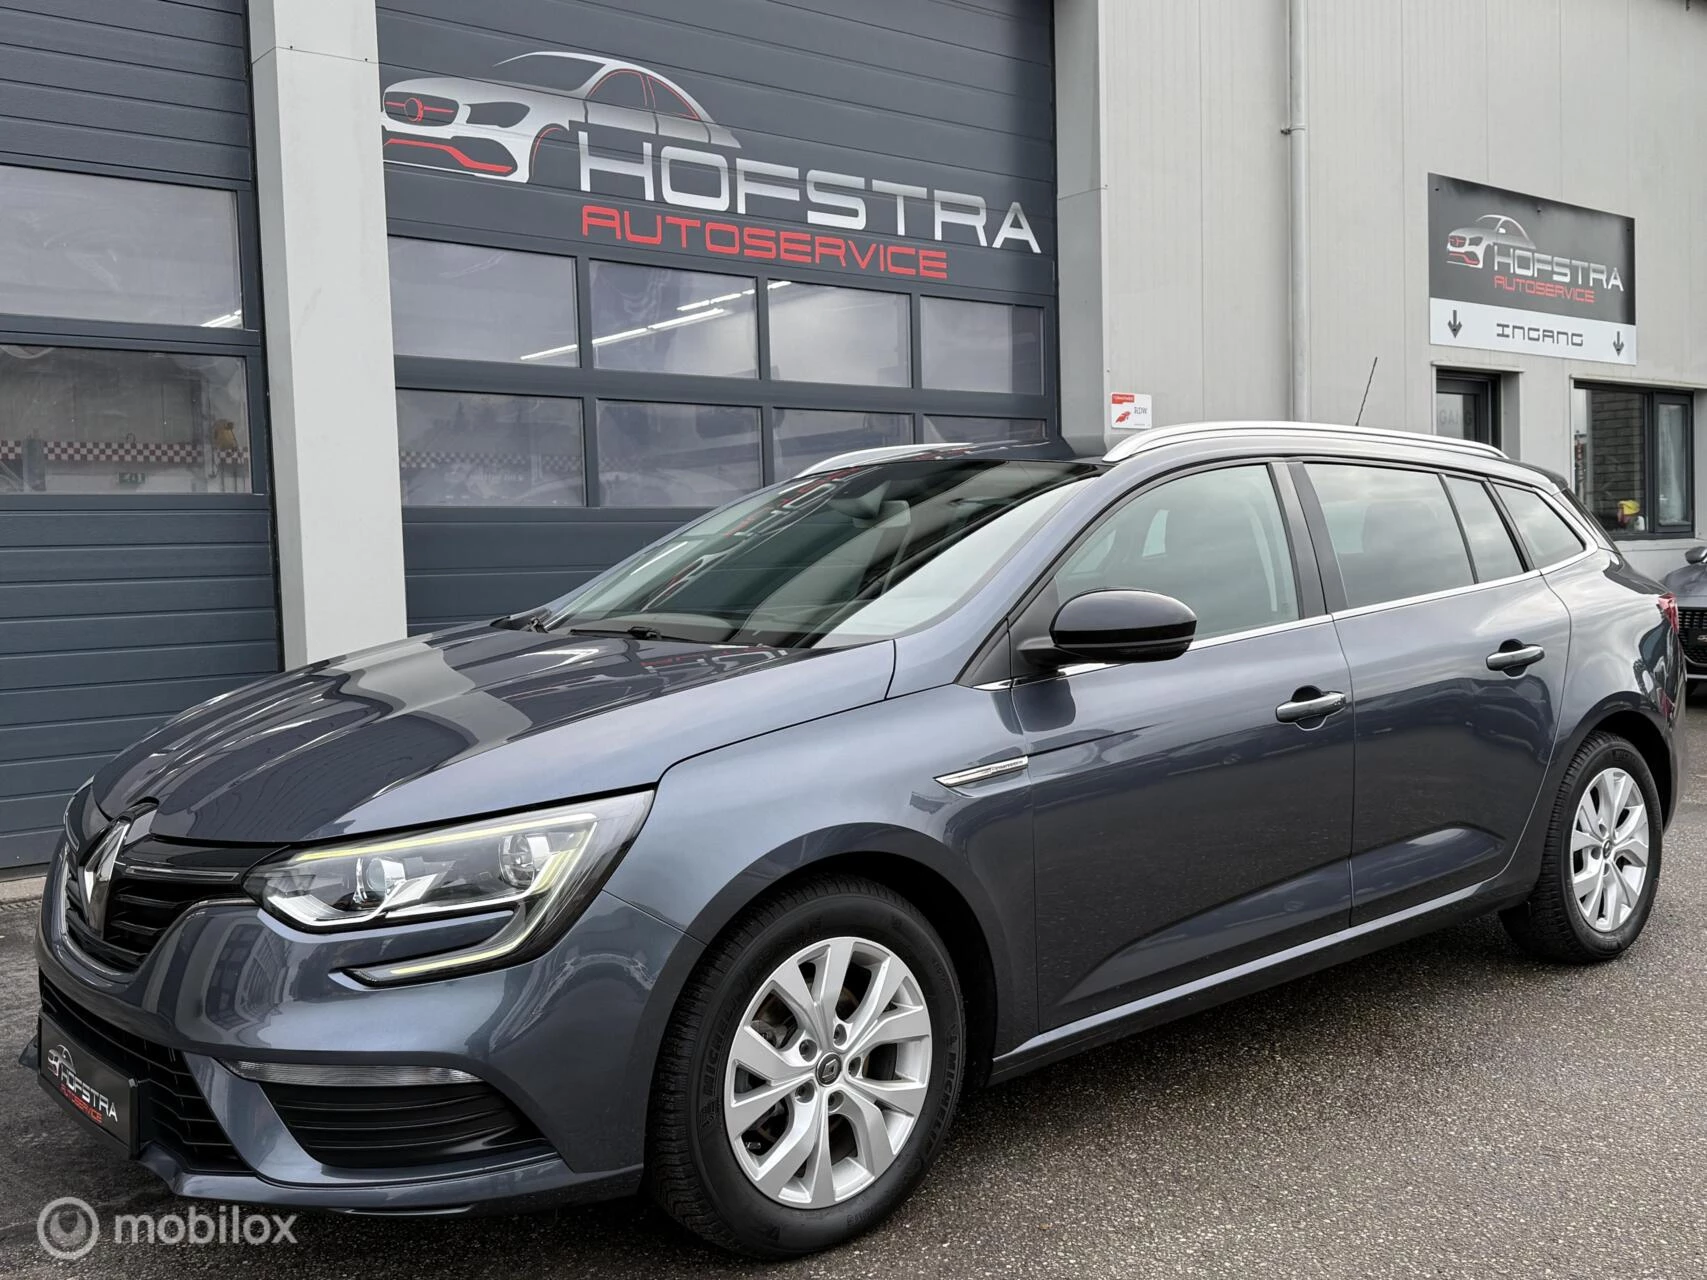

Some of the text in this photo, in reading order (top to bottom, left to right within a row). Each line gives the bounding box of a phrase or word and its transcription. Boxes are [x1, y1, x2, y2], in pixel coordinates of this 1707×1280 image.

[579, 131, 1042, 254] HOFSTRA
[580, 205, 948, 279] AUTOSERVICE
[1494, 245, 1624, 292] HOFSTRA
[1494, 275, 1595, 304] AUTOSERVICE
[1496, 323, 1583, 347] INGANG
[61, 1063, 118, 1122] HOFSTRA
